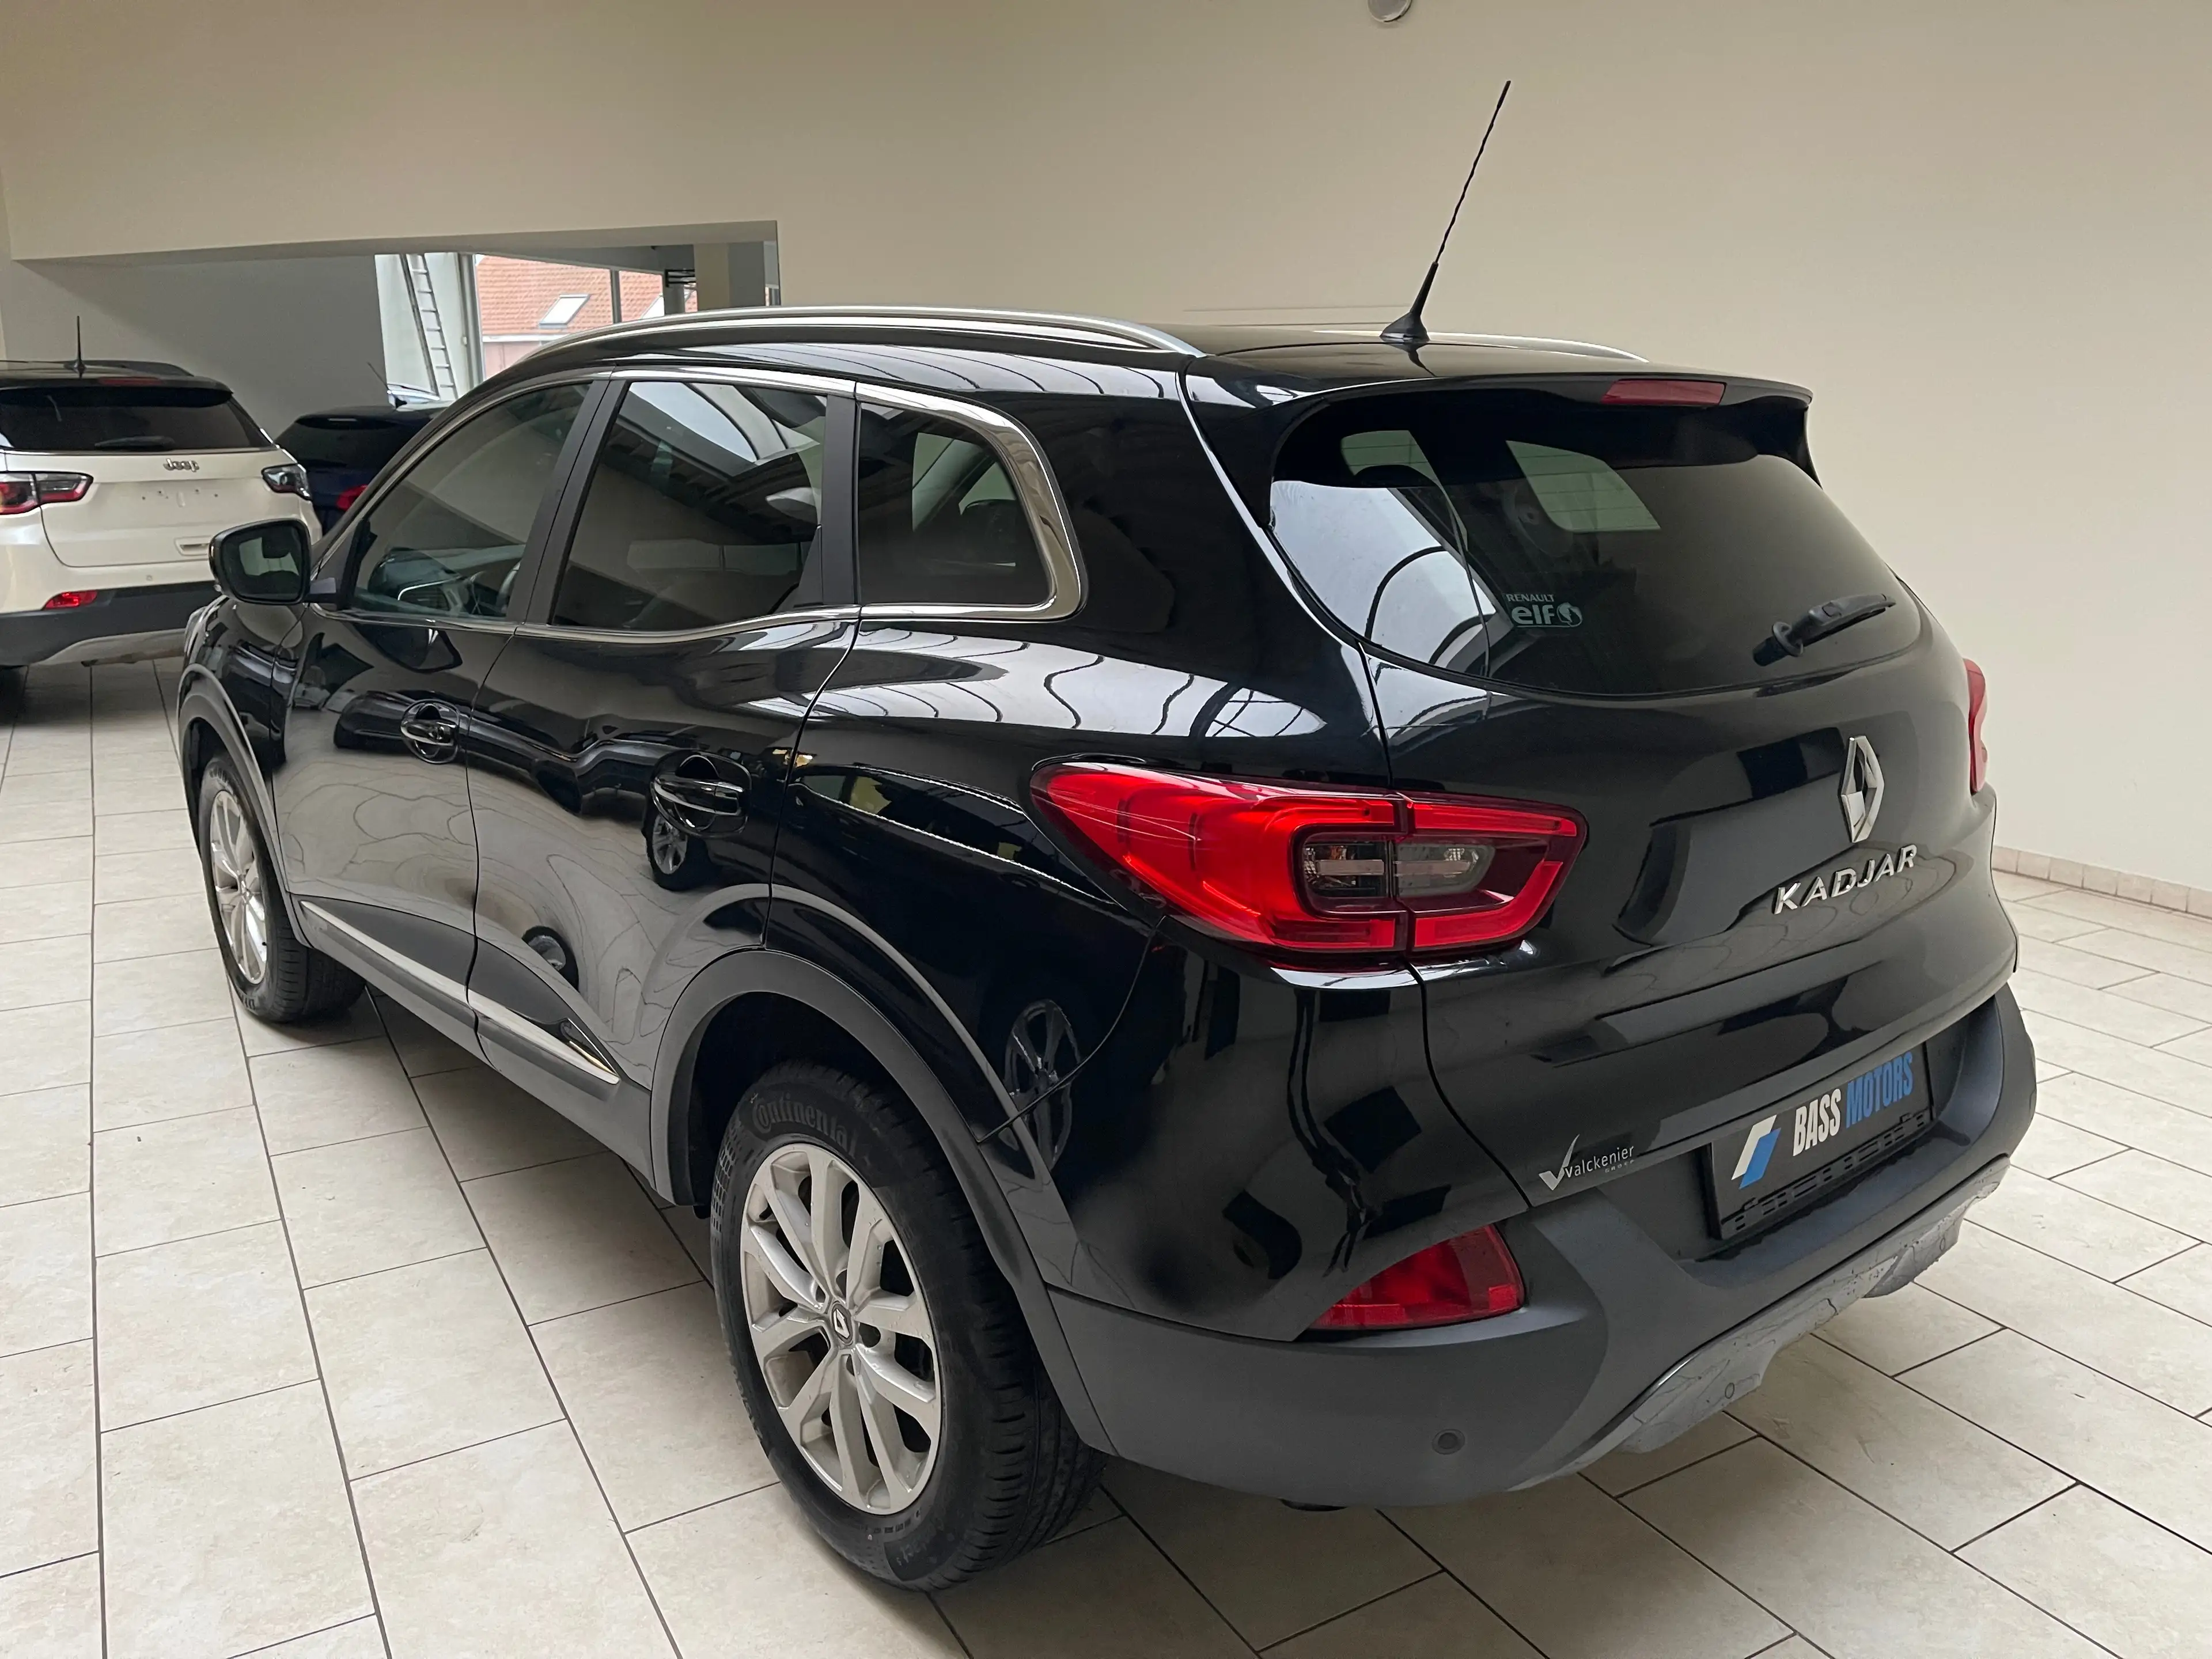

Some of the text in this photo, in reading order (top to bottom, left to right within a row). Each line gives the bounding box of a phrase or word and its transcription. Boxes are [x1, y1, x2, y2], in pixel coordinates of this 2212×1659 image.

[162, 458, 200, 473] Jeep
[1506, 593, 1555, 602] RENAULT
[1511, 604, 1555, 624] elf
[1773, 844, 1918, 915] KADJAR
[1793, 1051, 1914, 1157] BASS MOTORS
